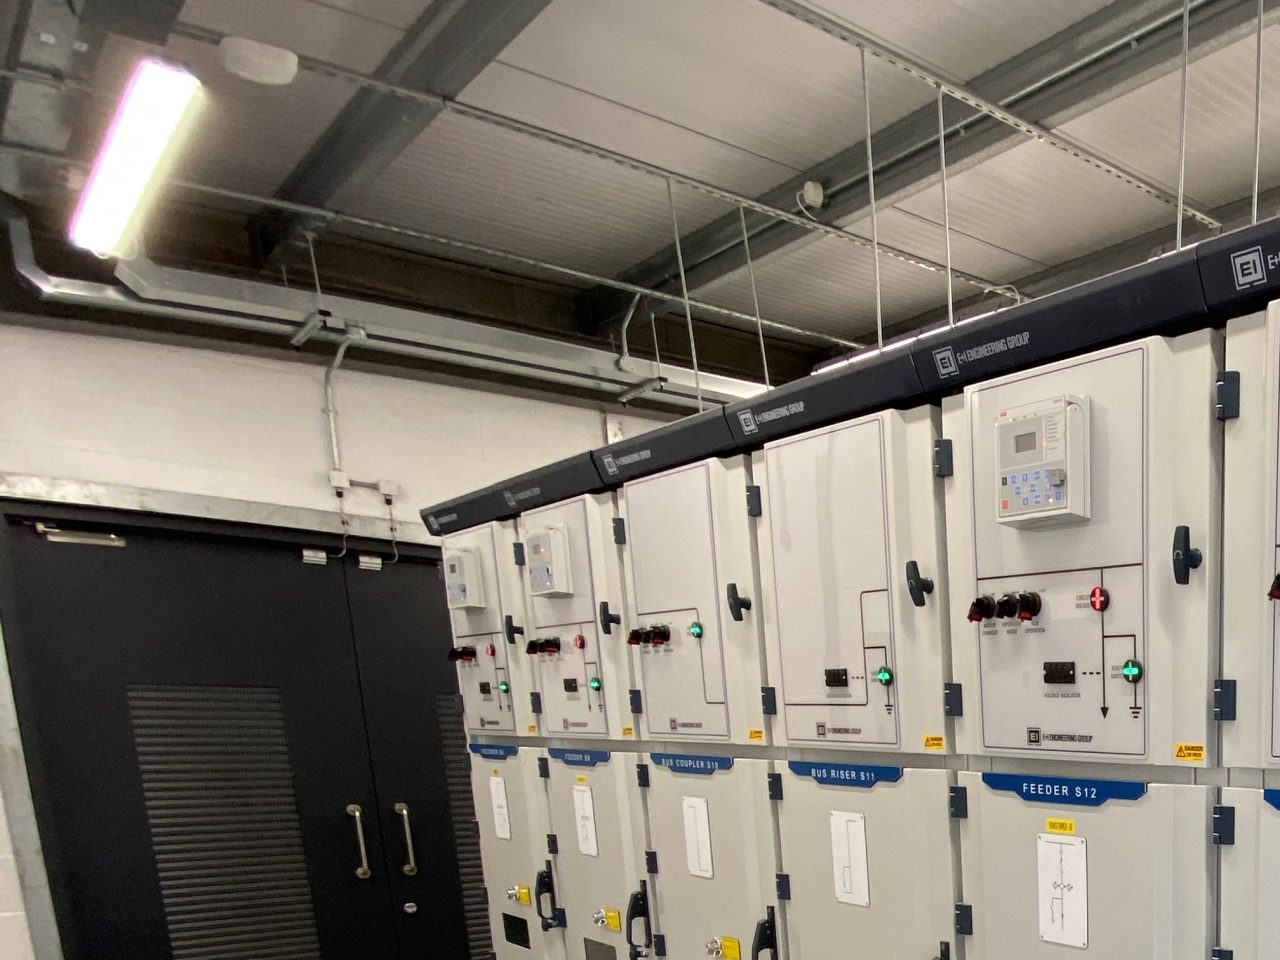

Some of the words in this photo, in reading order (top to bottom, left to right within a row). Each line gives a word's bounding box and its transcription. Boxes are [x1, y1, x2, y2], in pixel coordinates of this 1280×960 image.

[967, 339, 1008, 361] ENGINEERING
[1006, 332, 1030, 349] GROUP
[675, 758, 705, 769] COUPLER
[811, 768, 827, 778] BUS
[830, 769, 857, 780] RISER
[860, 771, 875, 781] S11
[1022, 782, 1069, 797] FEEDER
[1075, 786, 1097, 799] S12
